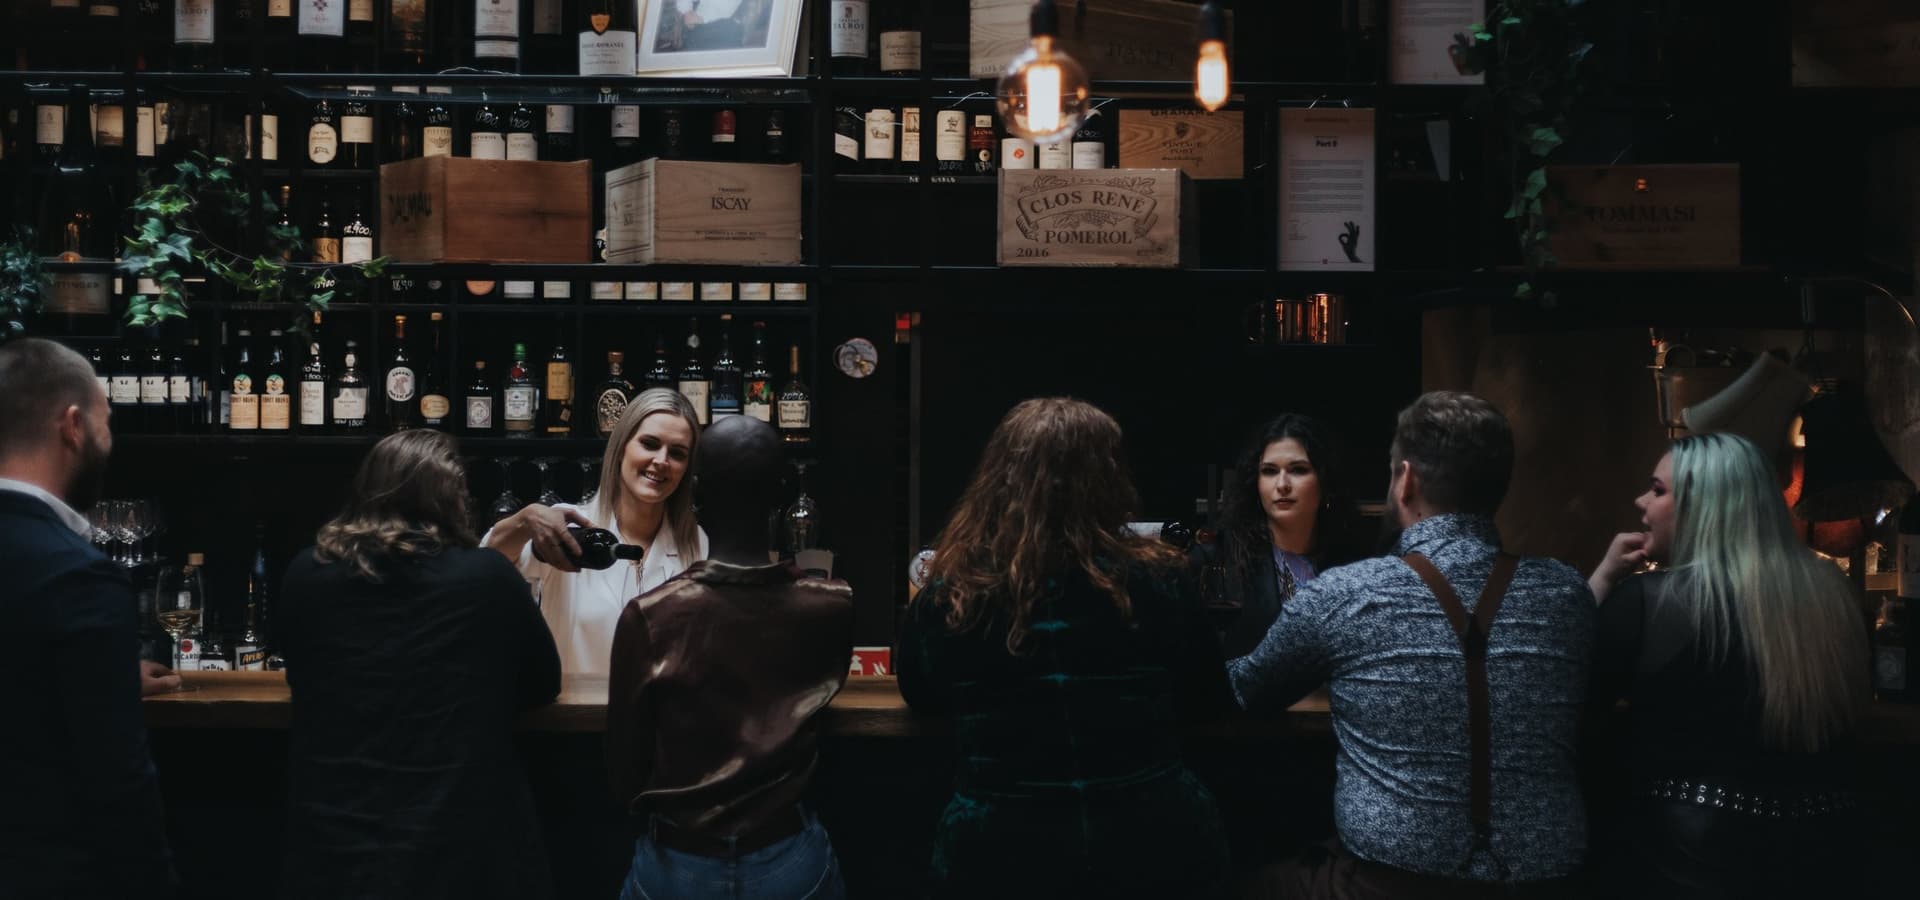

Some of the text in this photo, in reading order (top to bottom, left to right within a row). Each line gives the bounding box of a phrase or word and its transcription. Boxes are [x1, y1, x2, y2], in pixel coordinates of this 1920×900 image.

[711, 197, 752, 210] ISCAY
[1030, 190, 1145, 214] CLOS RENE
[1044, 230, 1133, 245] POMEROL
[1016, 248, 1049, 258] 2016
